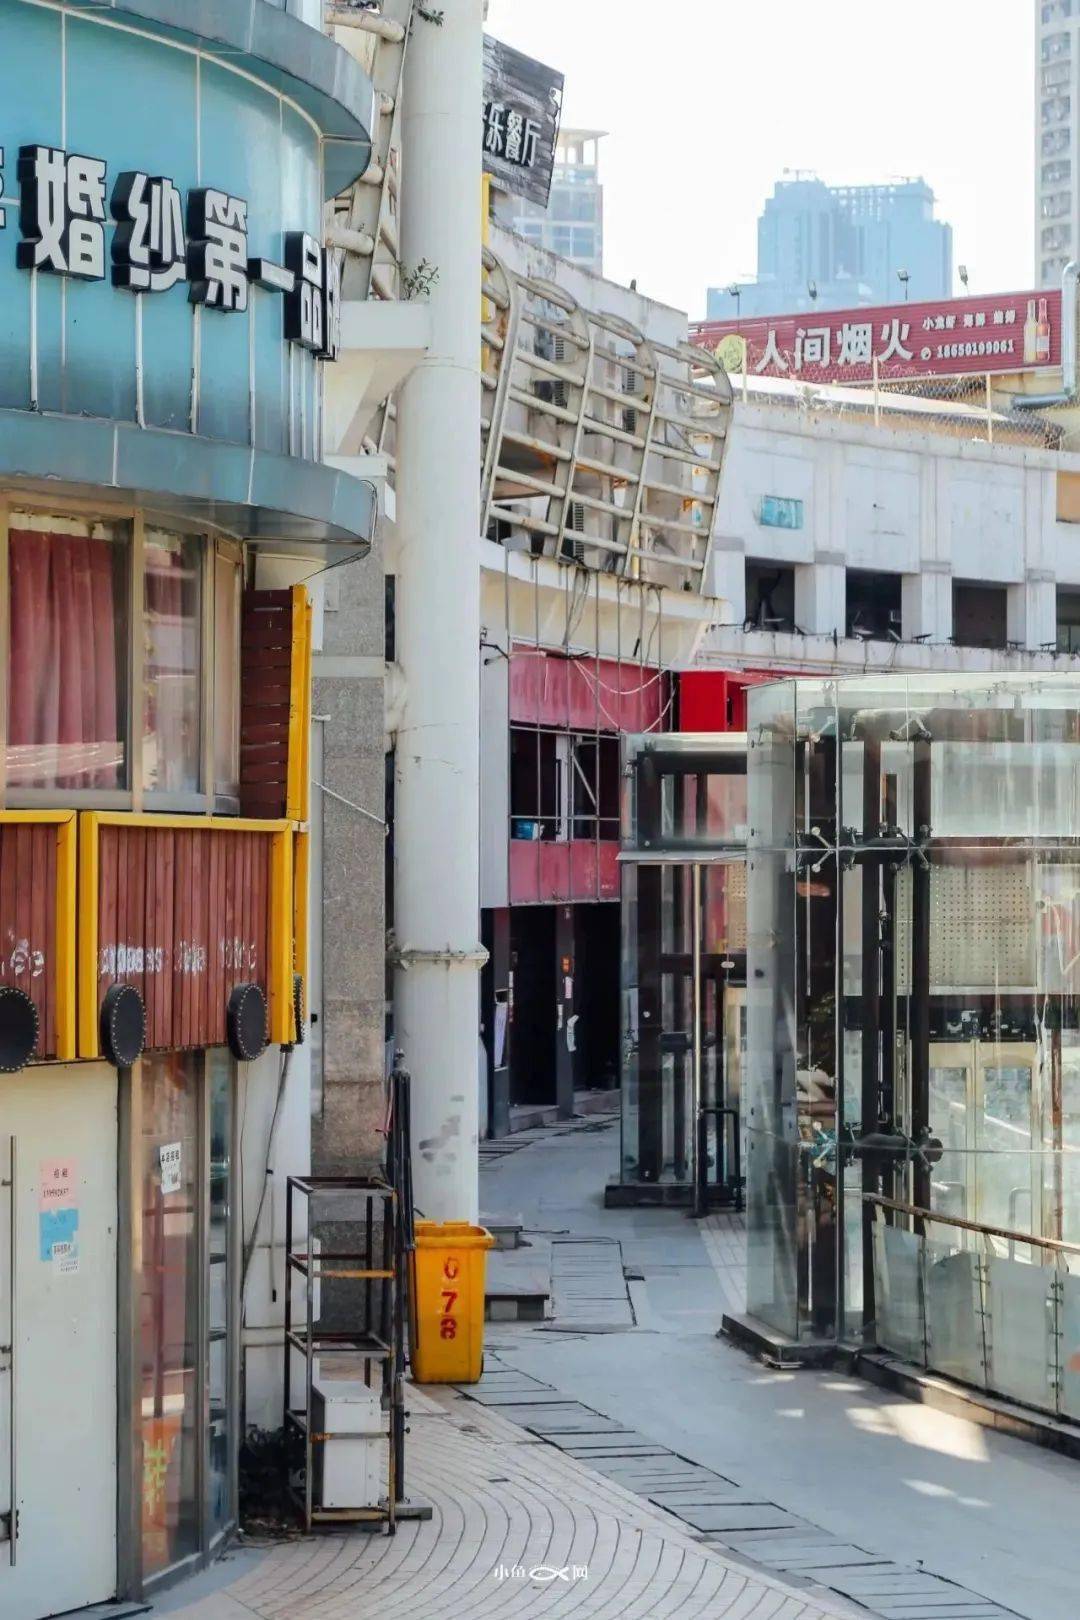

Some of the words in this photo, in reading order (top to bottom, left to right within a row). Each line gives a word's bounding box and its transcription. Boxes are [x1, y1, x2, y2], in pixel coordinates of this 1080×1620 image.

[481, 100, 542, 168] 乐餐厅
[755, 318, 914, 372] 人间烟火
